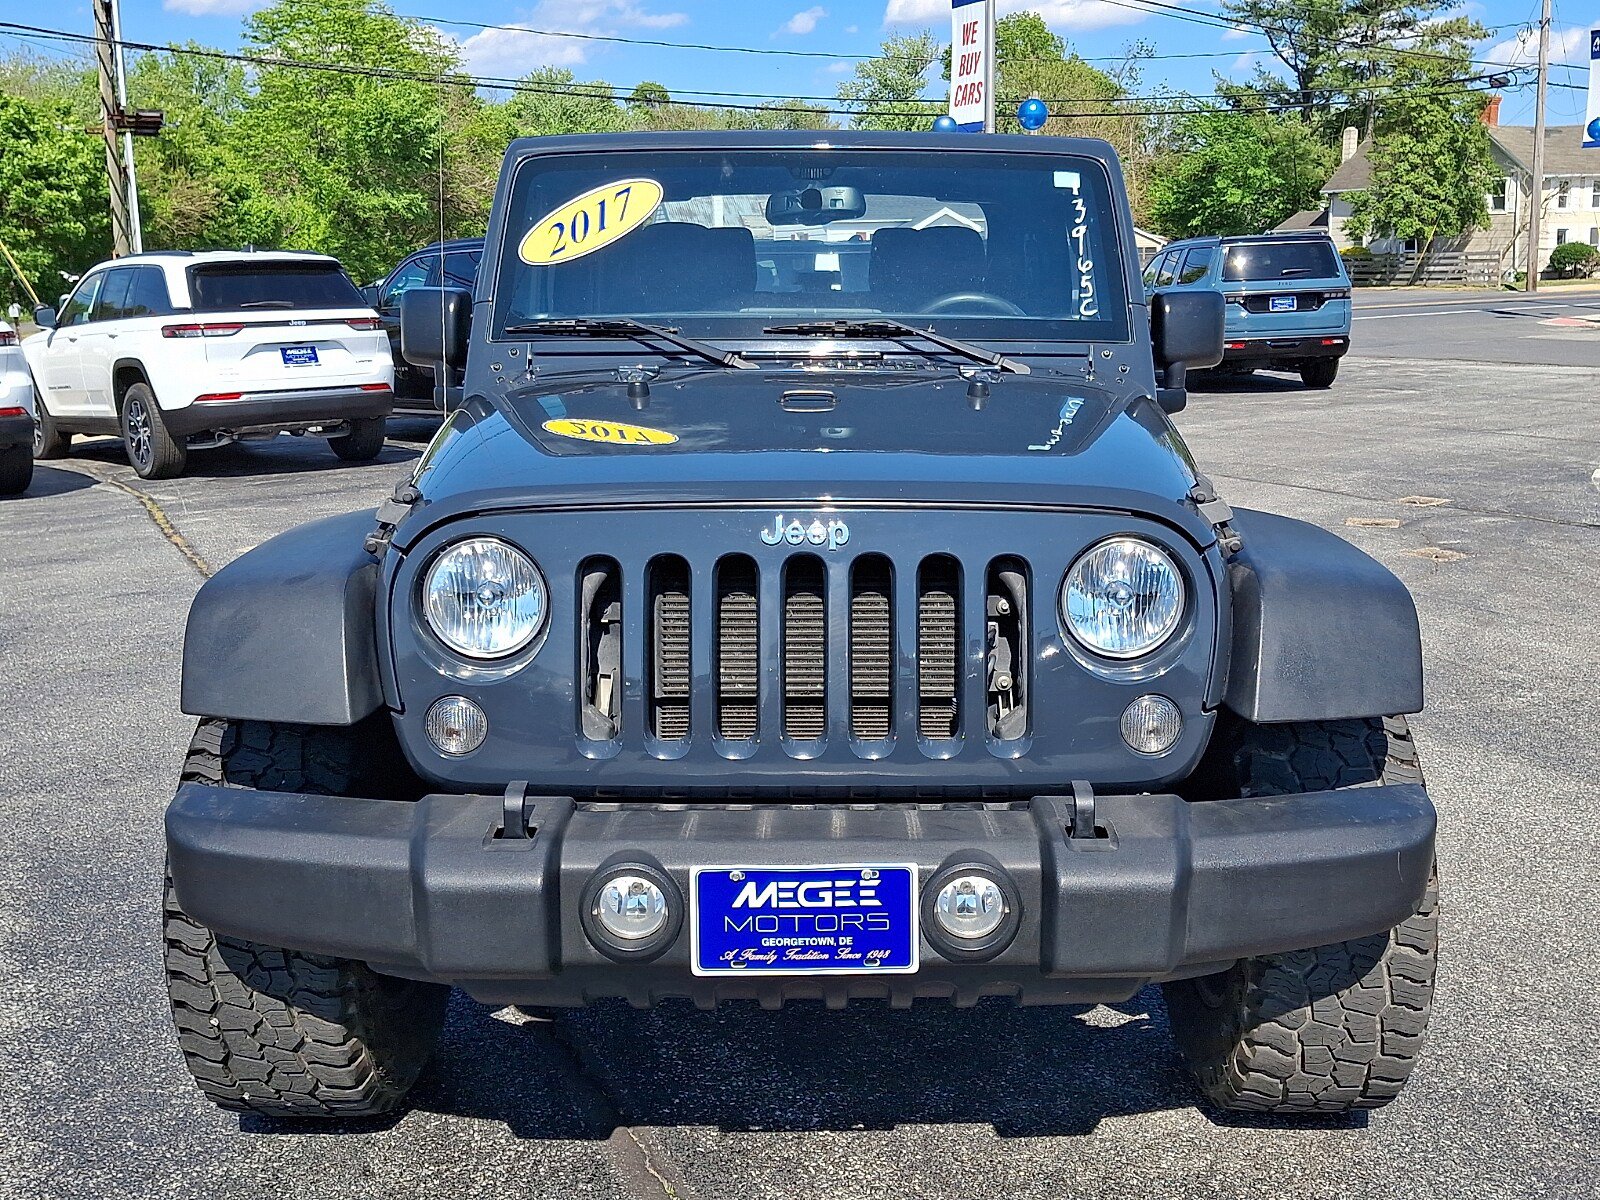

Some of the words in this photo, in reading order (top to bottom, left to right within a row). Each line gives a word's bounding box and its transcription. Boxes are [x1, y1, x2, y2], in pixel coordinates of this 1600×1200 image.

[962, 20, 979, 46] WE
[958, 50, 982, 78] BUY
[954, 81, 983, 108] CARS
[547, 185, 632, 259] 2017
[289, 319, 306, 327] Jeep
[760, 513, 850, 551] Jeep
[731, 879, 883, 908] MEGEE
[724, 912, 890, 933] MOTORS
[761, 937, 837, 947] GEORGETOWN,
[838, 936, 854, 946] DE
[719, 948, 740, 962] A
[738, 948, 778, 965] Family
[782, 948, 830, 962] Tradition
[834, 947, 862, 960] Since
[866, 949, 891, 960] 1948
